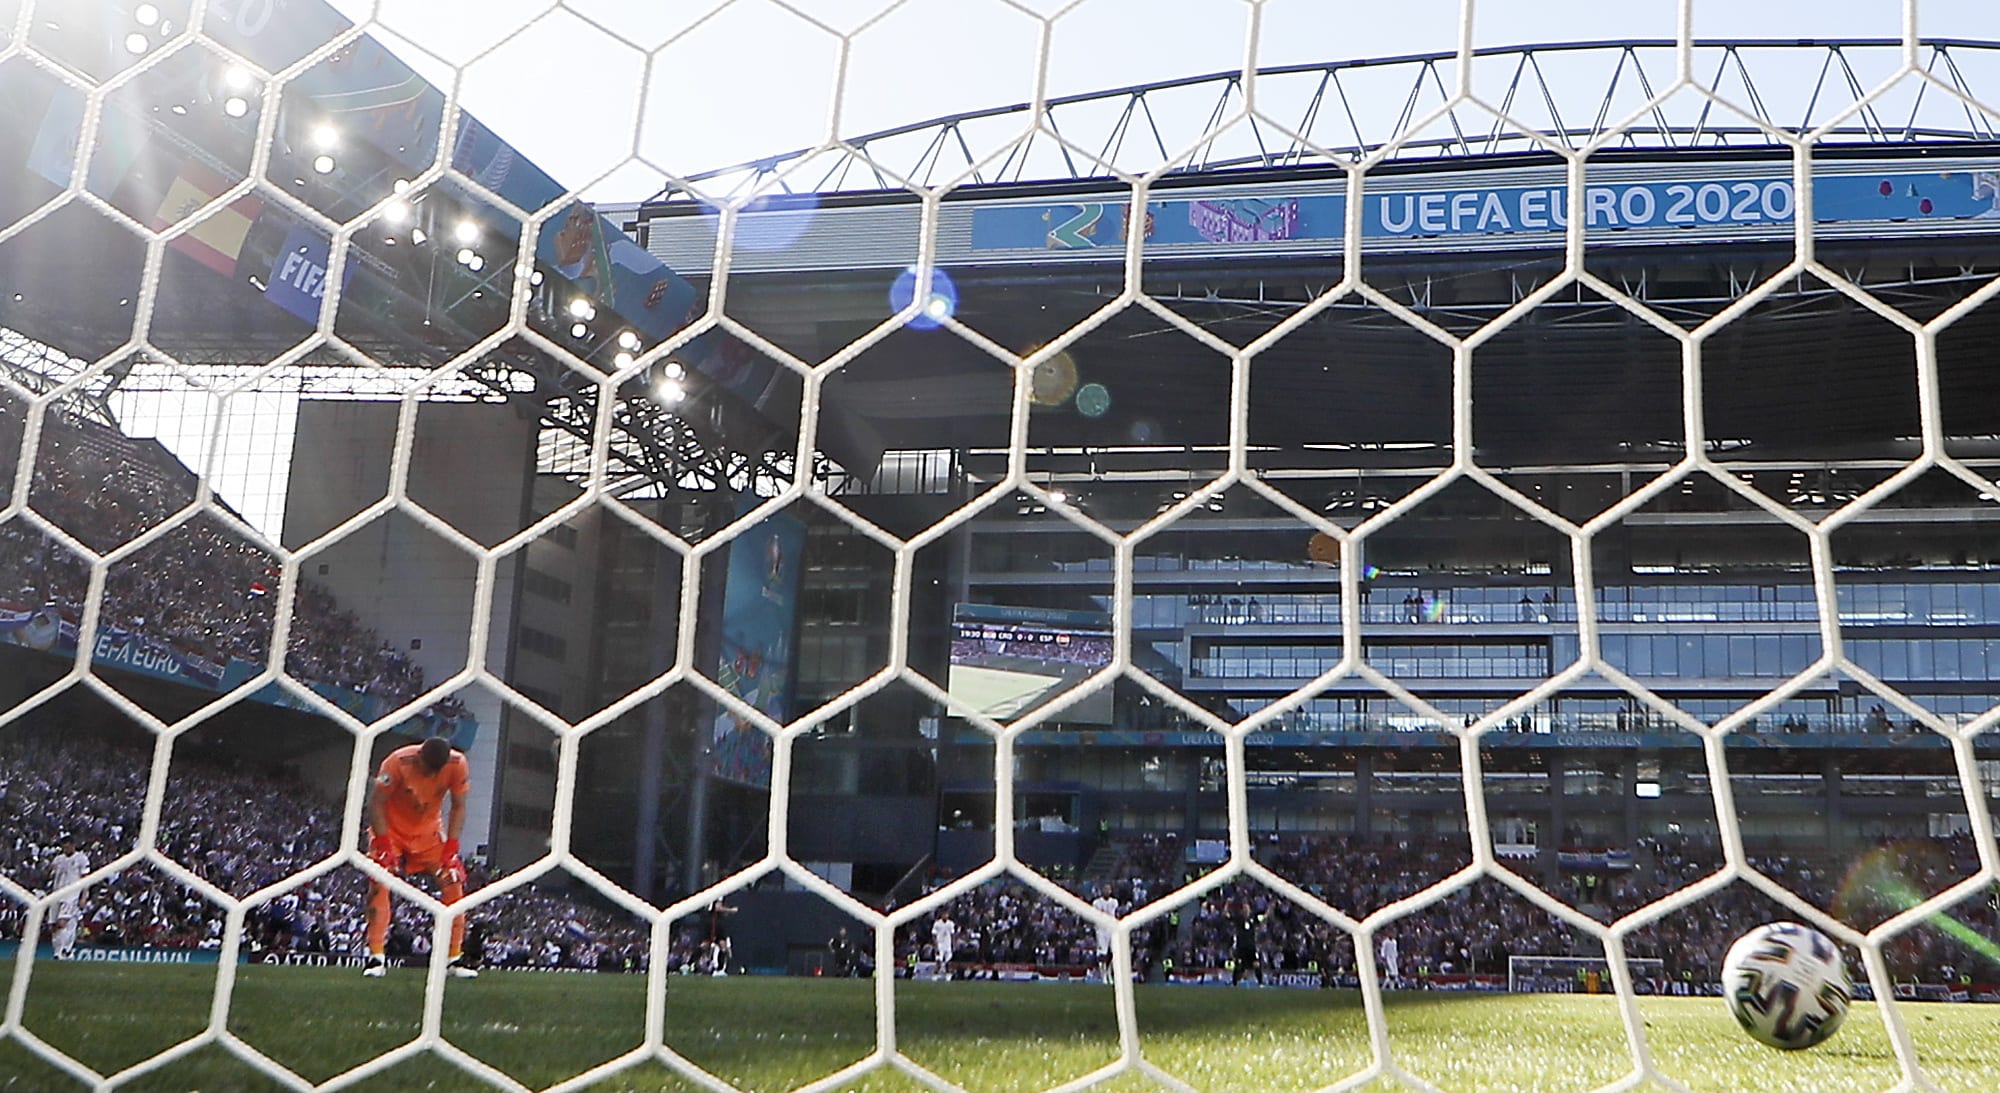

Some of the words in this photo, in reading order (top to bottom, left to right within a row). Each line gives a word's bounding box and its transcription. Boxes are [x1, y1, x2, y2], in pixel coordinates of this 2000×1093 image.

[1380, 192, 1511, 234] UEFA
[1664, 181, 1795, 224] 2020
[95, 633, 130, 664] EFA
[1557, 735, 1642, 746] COPENHAGEN
